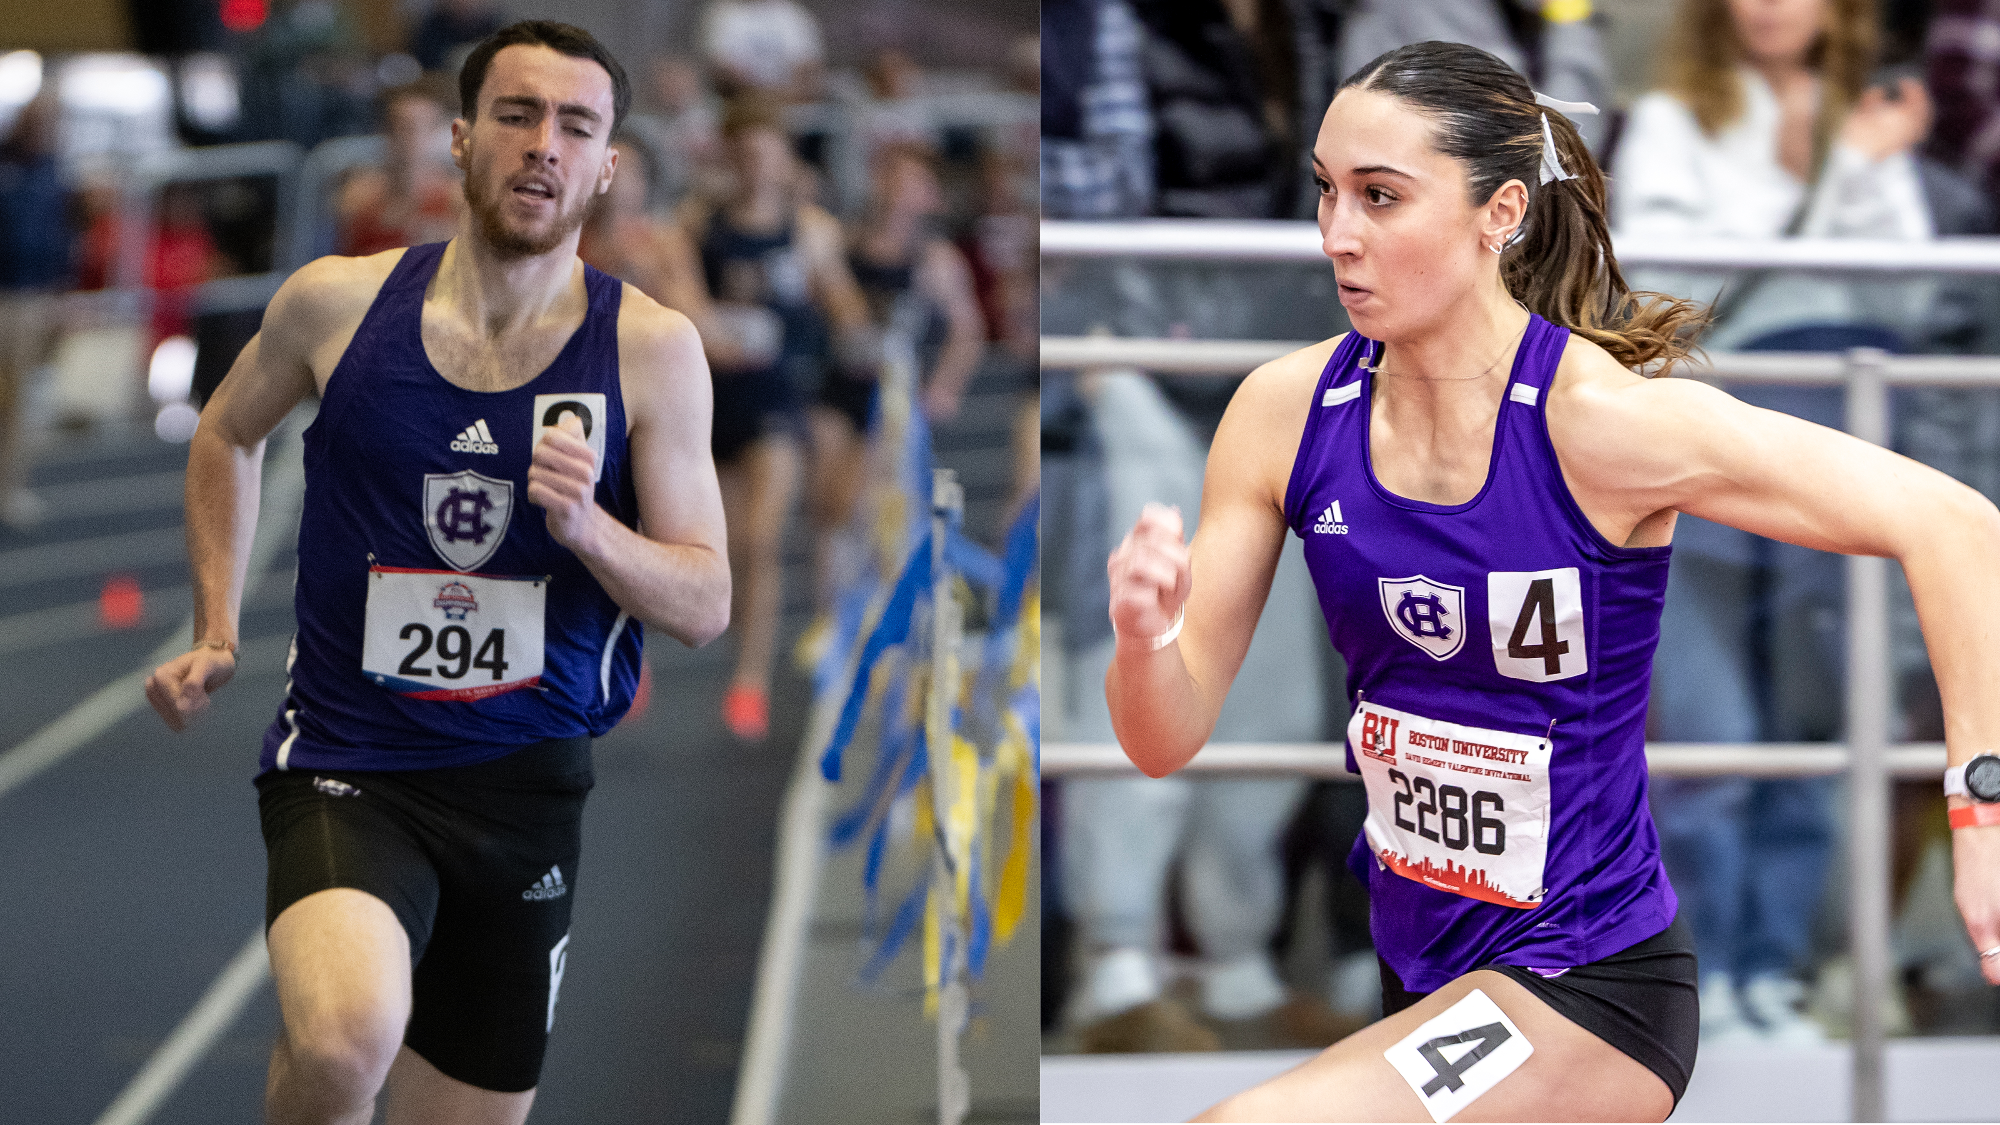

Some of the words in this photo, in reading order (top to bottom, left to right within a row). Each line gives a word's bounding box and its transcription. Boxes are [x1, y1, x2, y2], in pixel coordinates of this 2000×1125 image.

[450, 439, 499, 455] adidas
[1314, 521, 1349, 535] adidas
[1507, 578, 1570, 676] 4
[398, 622, 509, 681] 294
[1361, 711, 1400, 757] BU
[1408, 730, 1450, 753] BOSTON
[1452, 739, 1529, 765] UNIVERSITY
[1448, 762, 1484, 776] VALENTINE
[1484, 768, 1532, 783] INVITATIONAL
[1388, 768, 1507, 856] 2286
[1416, 1021, 1513, 1099] 4
